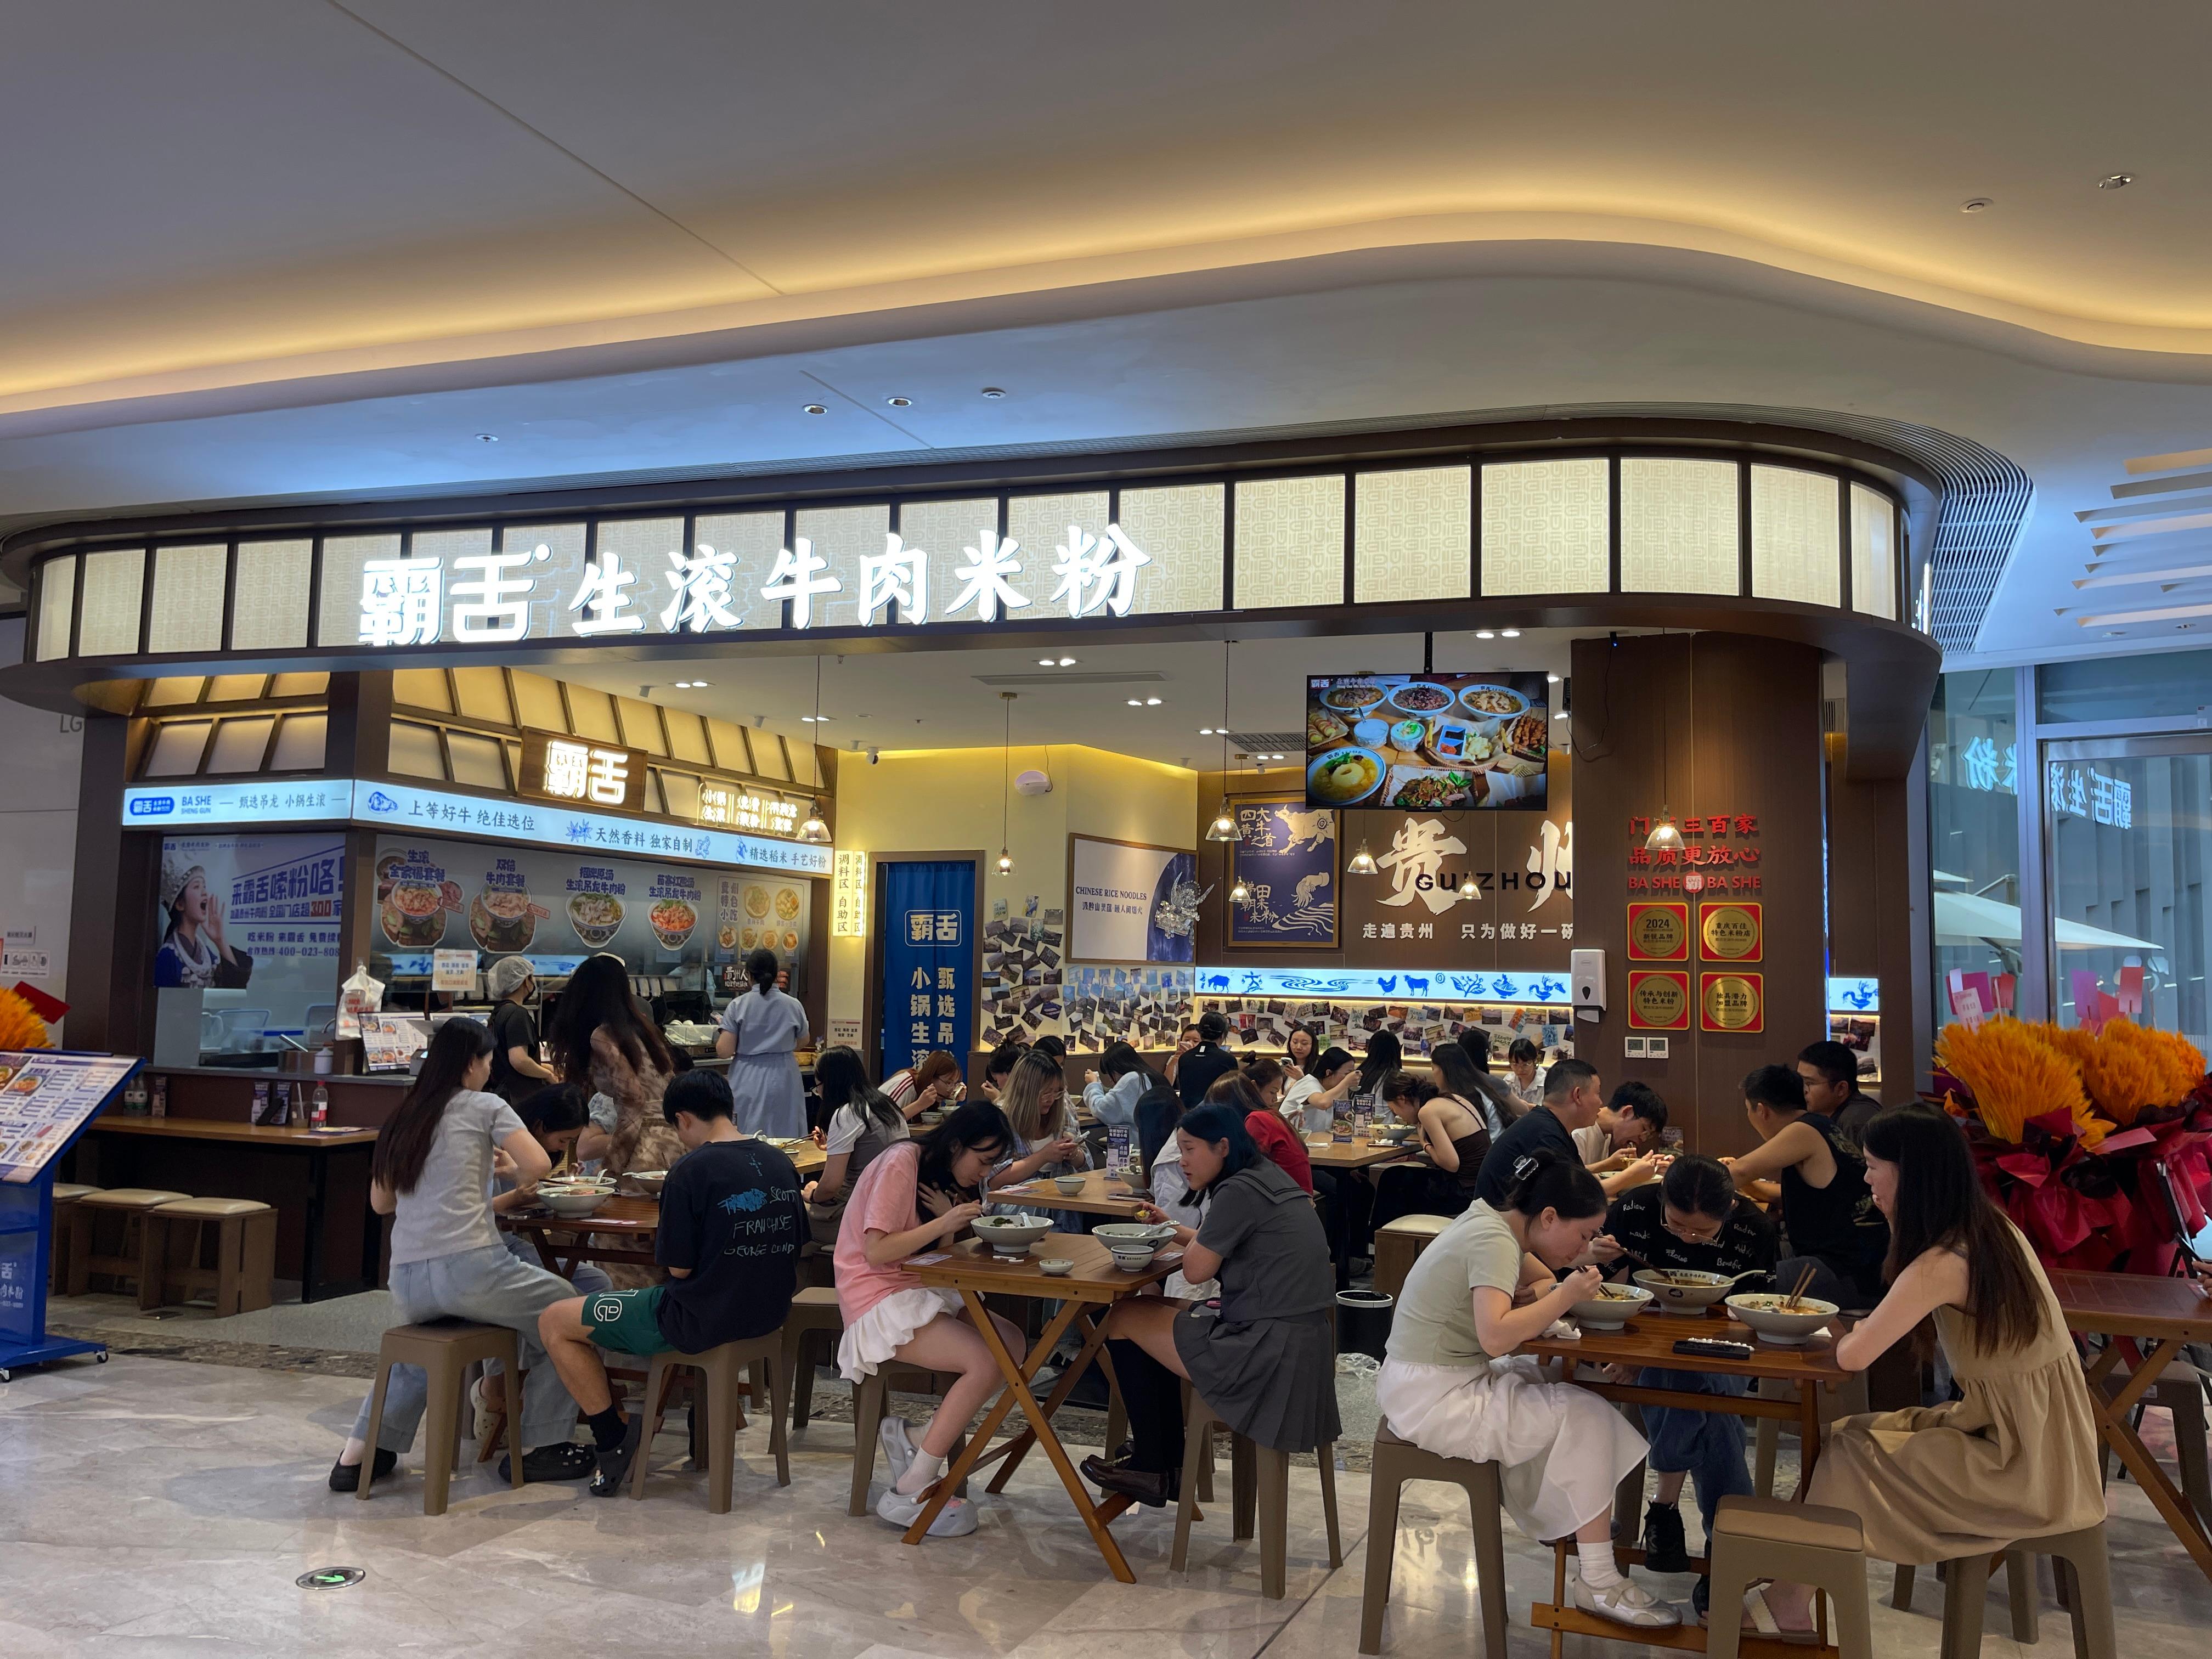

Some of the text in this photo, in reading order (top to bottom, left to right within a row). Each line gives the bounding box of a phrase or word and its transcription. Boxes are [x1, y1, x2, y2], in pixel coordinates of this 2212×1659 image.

[358, 523, 1153, 646] 霸舌 生滚牛肉米粉
[543, 741, 628, 804] 霸舌
[182, 797, 193, 806] BA
[195, 795, 212, 806] SHE
[409, 800, 535, 832] 上等好牛 绝佳选位
[1240, 807, 1272, 822] 四大
[1629, 813, 1759, 836] 门三百家
[1240, 820, 1271, 838] 黄牛
[595, 827, 692, 853] 天然香料 独家自制
[749, 847, 826, 868] 精选稻米 手艺好粉
[1628, 844, 1761, 866] 品质更放心
[486, 872, 526, 887] 牛肉套餐
[838, 854, 849, 889] 调料区
[1415, 871, 1571, 891] GUZHOU
[1628, 877, 1649, 889] BA
[1652, 877, 1680, 889] SHE
[1707, 876, 1728, 888] BA
[1731, 876, 1761, 888] SHE
[1076, 887, 1147, 900] CHINESE RICE NOODLES
[837, 896, 848, 932] 自助区
[1646, 919, 1669, 928] 2024
[910, 913, 958, 941] 霸舌
[1363, 923, 1433, 939] 走遍贵州
[910, 967, 931, 1070] 小锅生滚
[937, 967, 955, 1058] 甄选吊
[770, 1186, 798, 1204] SCOTT
